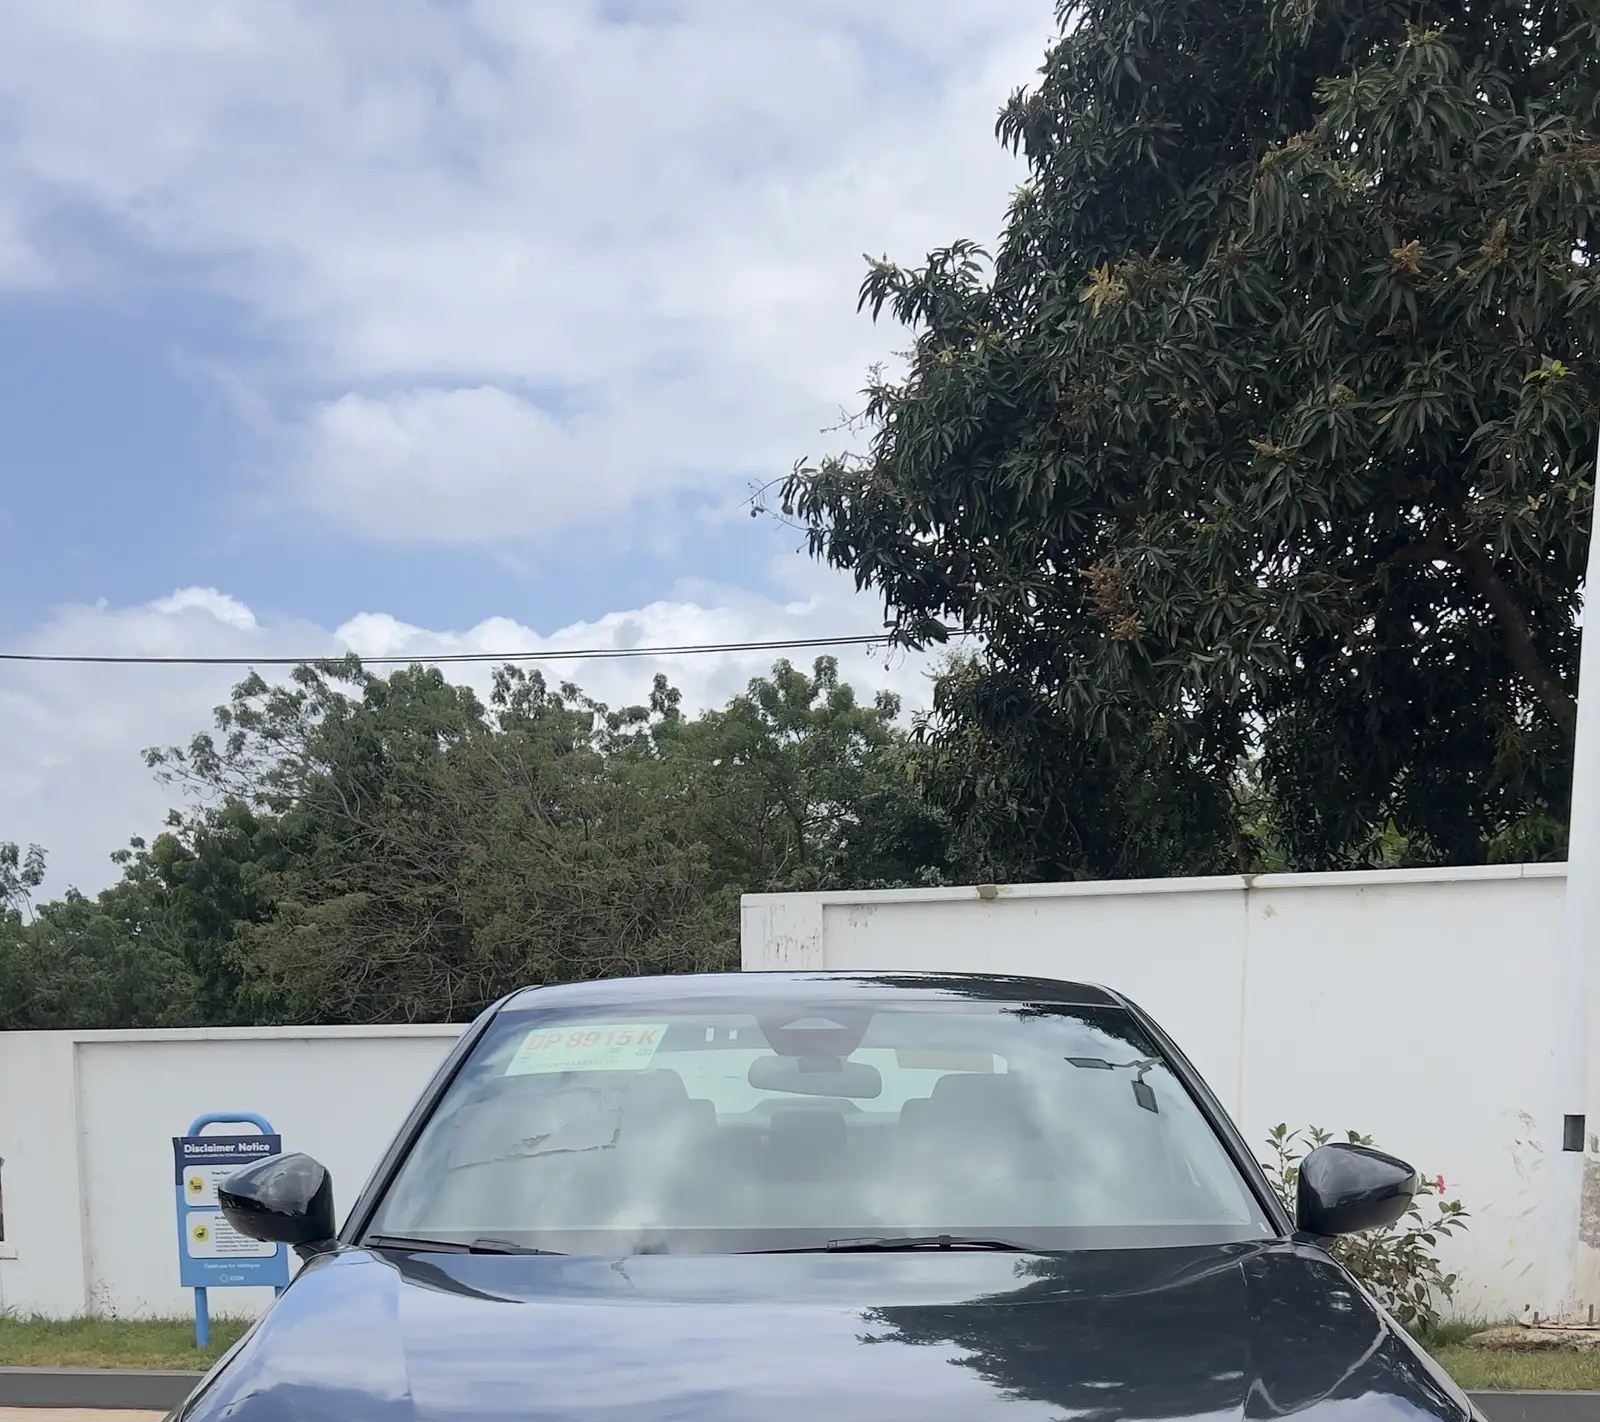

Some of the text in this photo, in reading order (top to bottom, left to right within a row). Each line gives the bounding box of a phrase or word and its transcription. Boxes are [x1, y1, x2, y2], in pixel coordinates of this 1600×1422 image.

[526, 1033, 563, 1051] DP
[636, 1028, 660, 1046] K
[184, 1142, 270, 1153] Disclaimer Notice
